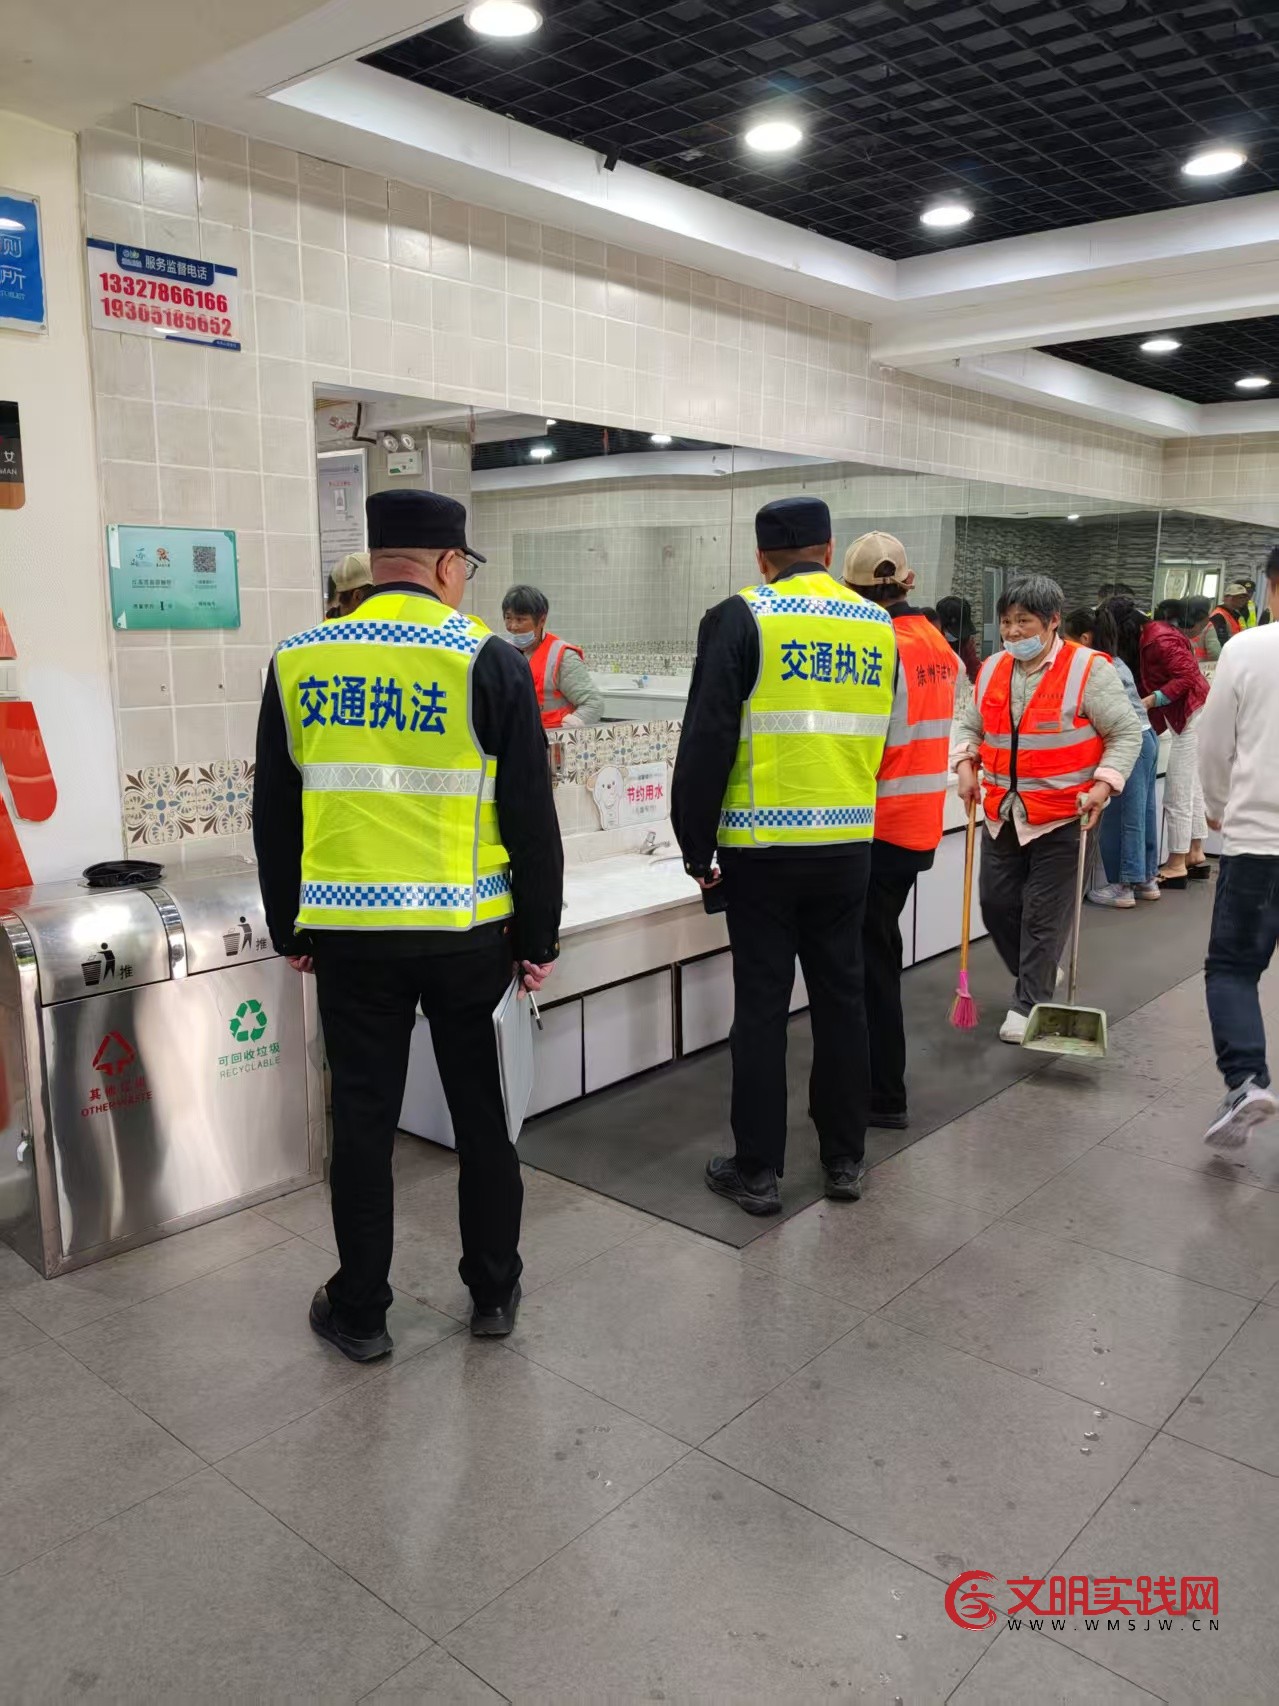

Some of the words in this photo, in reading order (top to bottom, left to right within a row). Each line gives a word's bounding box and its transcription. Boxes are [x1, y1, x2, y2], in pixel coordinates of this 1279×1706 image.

[145, 254, 208, 280] 服务监督电话
[99, 272, 228, 313] 13327866166
[101, 297, 232, 337] 19305185652
[4, 450, 16, 464] 女
[781, 639, 882, 687] 交通执法
[298, 674, 447, 736] 交通执法
[627, 783, 663, 805] 节约用水
[256, 937, 268, 951] 推
[119, 964, 133, 980] 推
[218, 1042, 280, 1066] 可回收垃圾
[219, 1055, 281, 1079] RECYCLABLE
